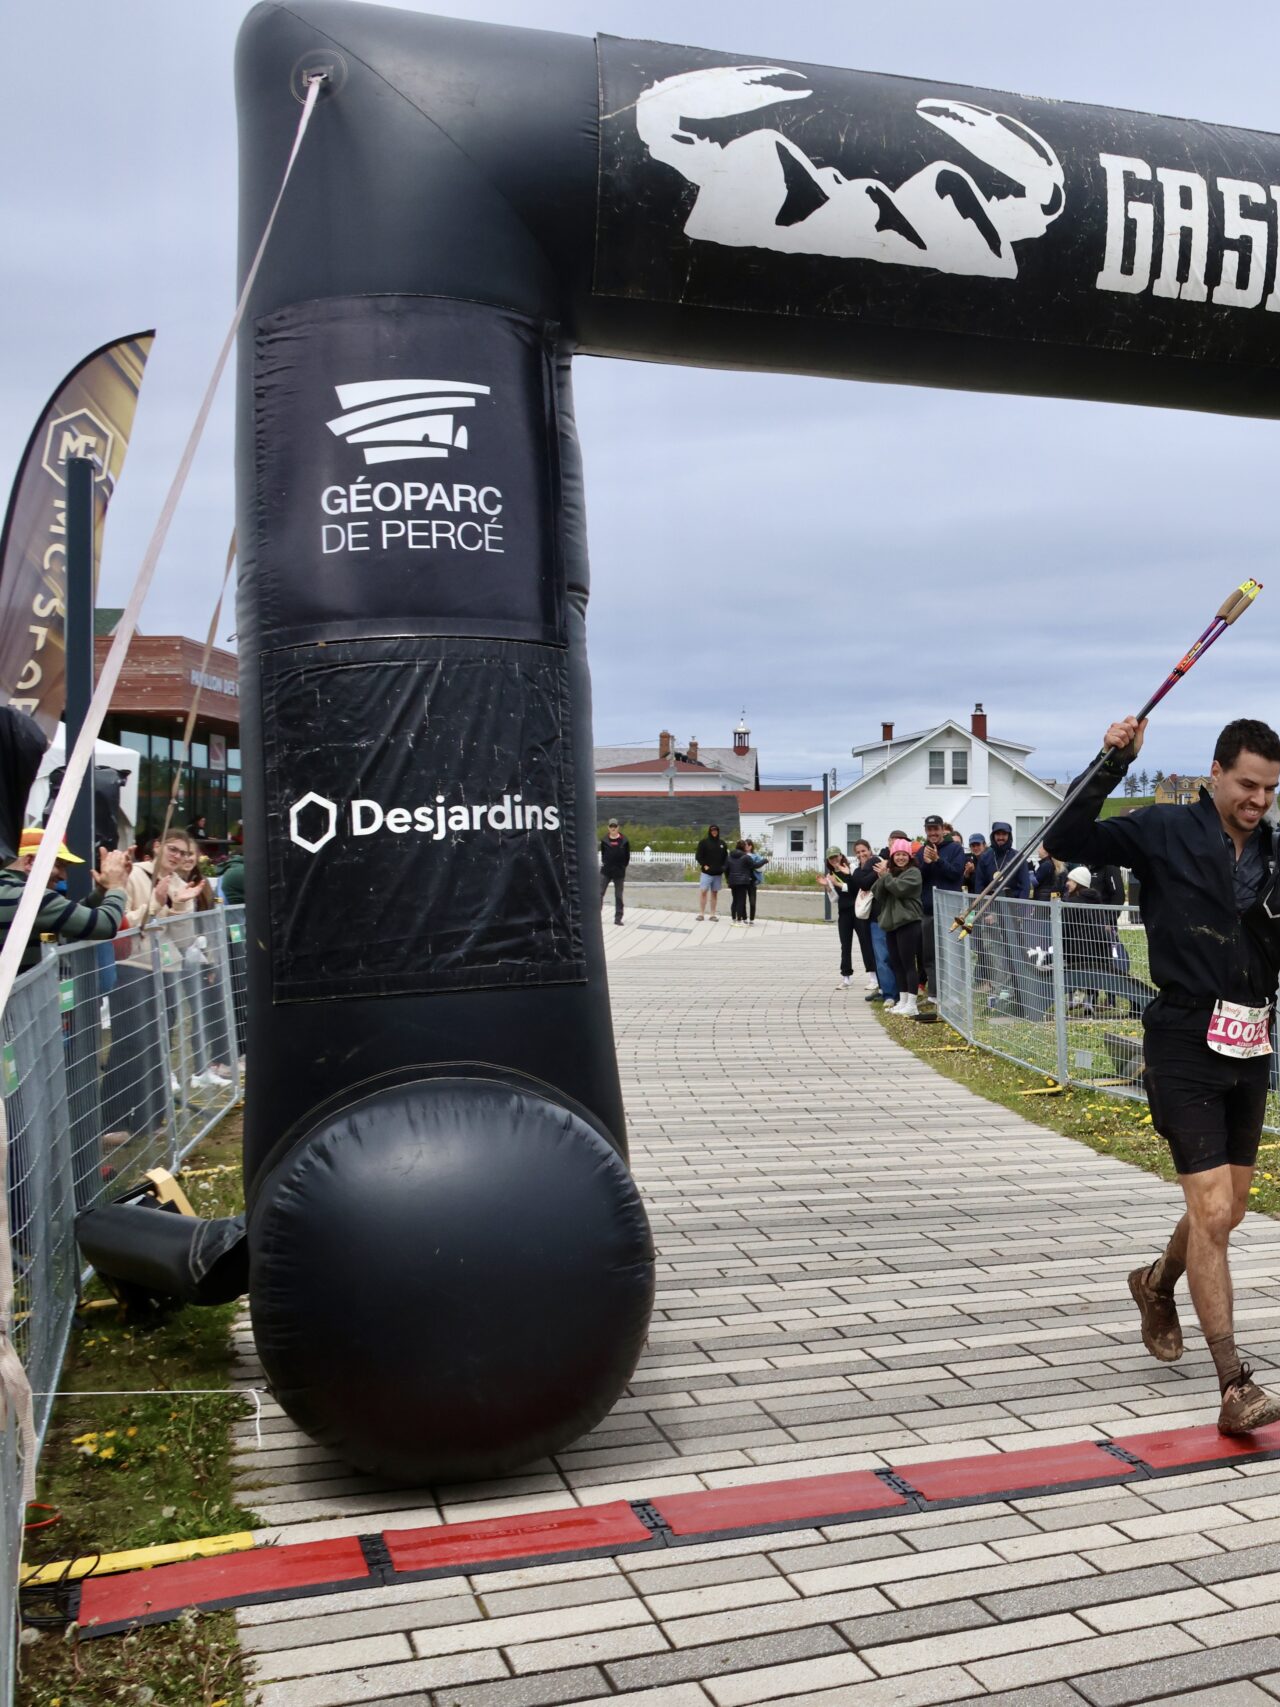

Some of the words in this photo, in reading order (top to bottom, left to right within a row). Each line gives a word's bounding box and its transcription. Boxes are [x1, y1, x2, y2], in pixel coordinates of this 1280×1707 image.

[320, 475, 503, 516] GÉOPARC
[321, 521, 371, 554] DE
[381, 517, 505, 554] PERCÉ
[351, 794, 560, 844] Desjardins
